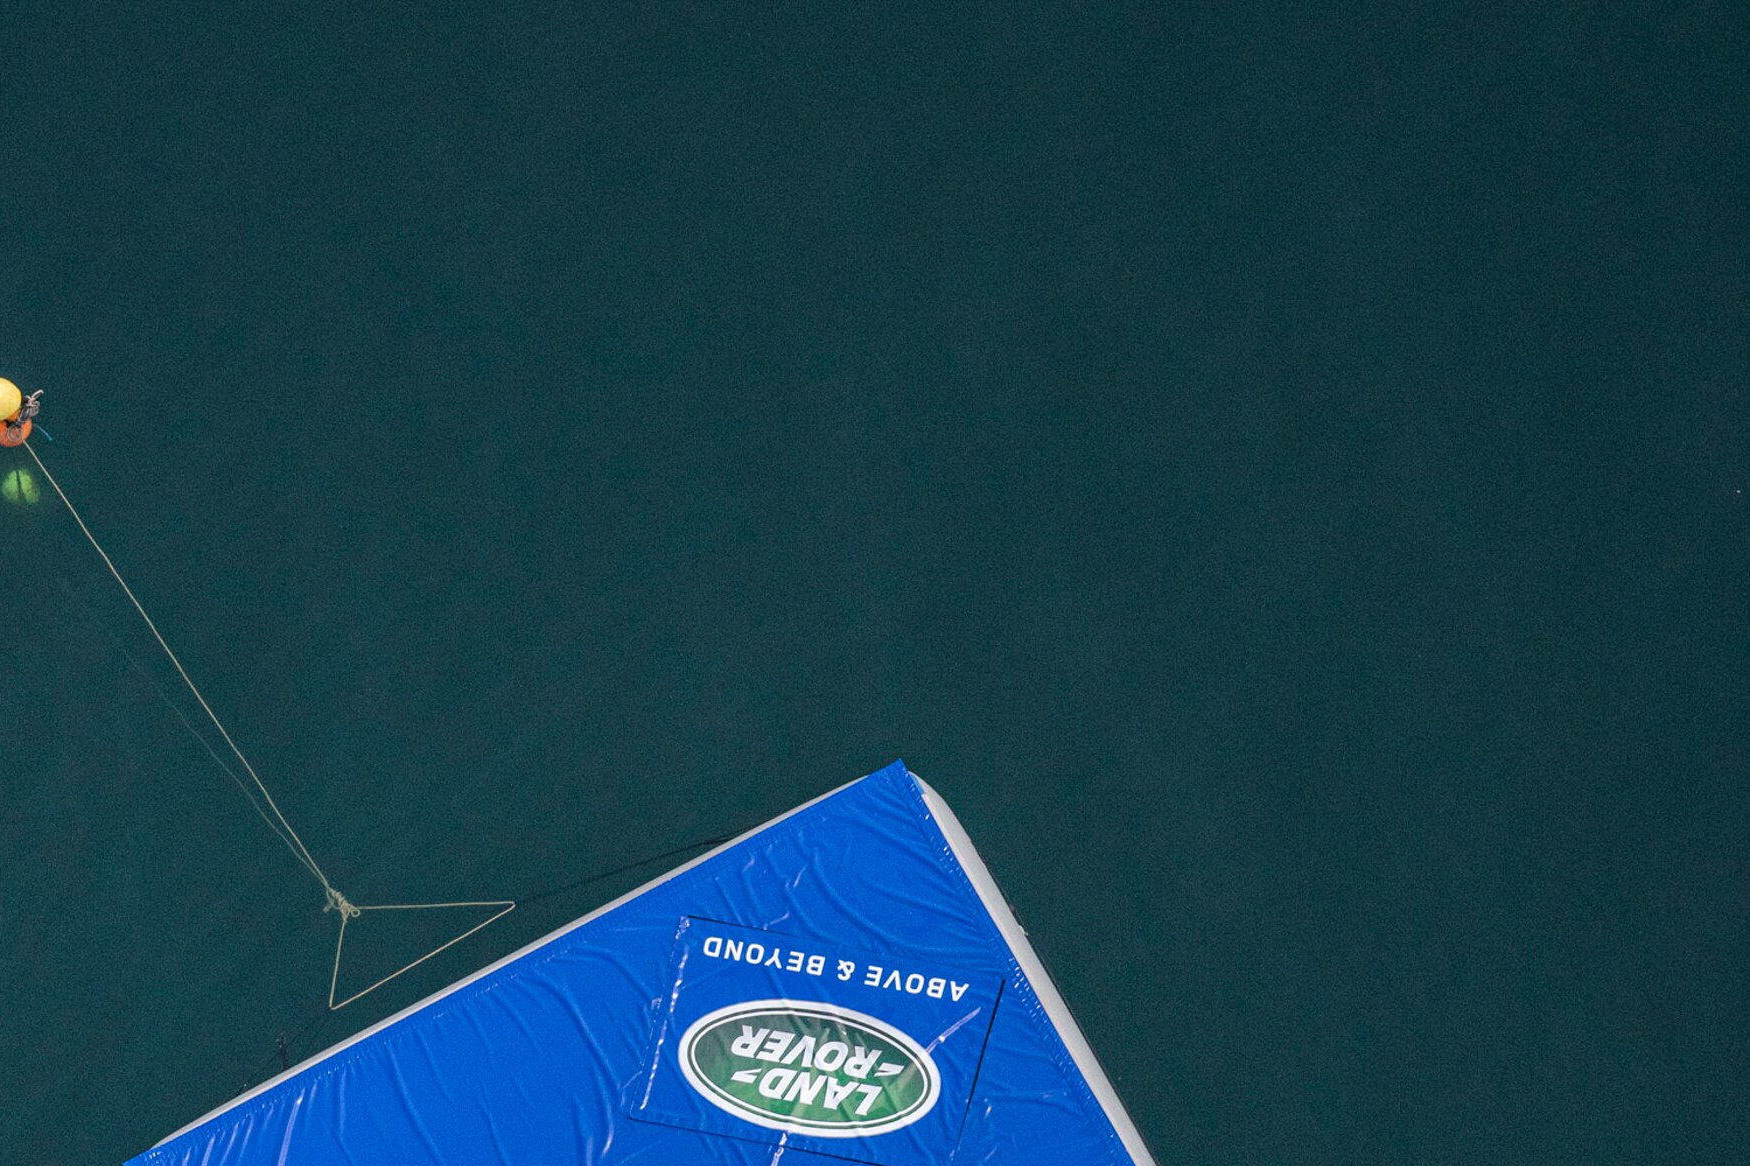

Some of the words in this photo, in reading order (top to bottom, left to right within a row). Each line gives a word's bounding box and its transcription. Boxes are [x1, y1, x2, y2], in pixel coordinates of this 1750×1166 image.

[703, 936, 826, 976] BEYOND
[837, 960, 855, 981] &
[864, 966, 969, 1002] ABOVE
[731, 1025, 882, 1079] ROVER
[758, 1068, 882, 1116] LAND
